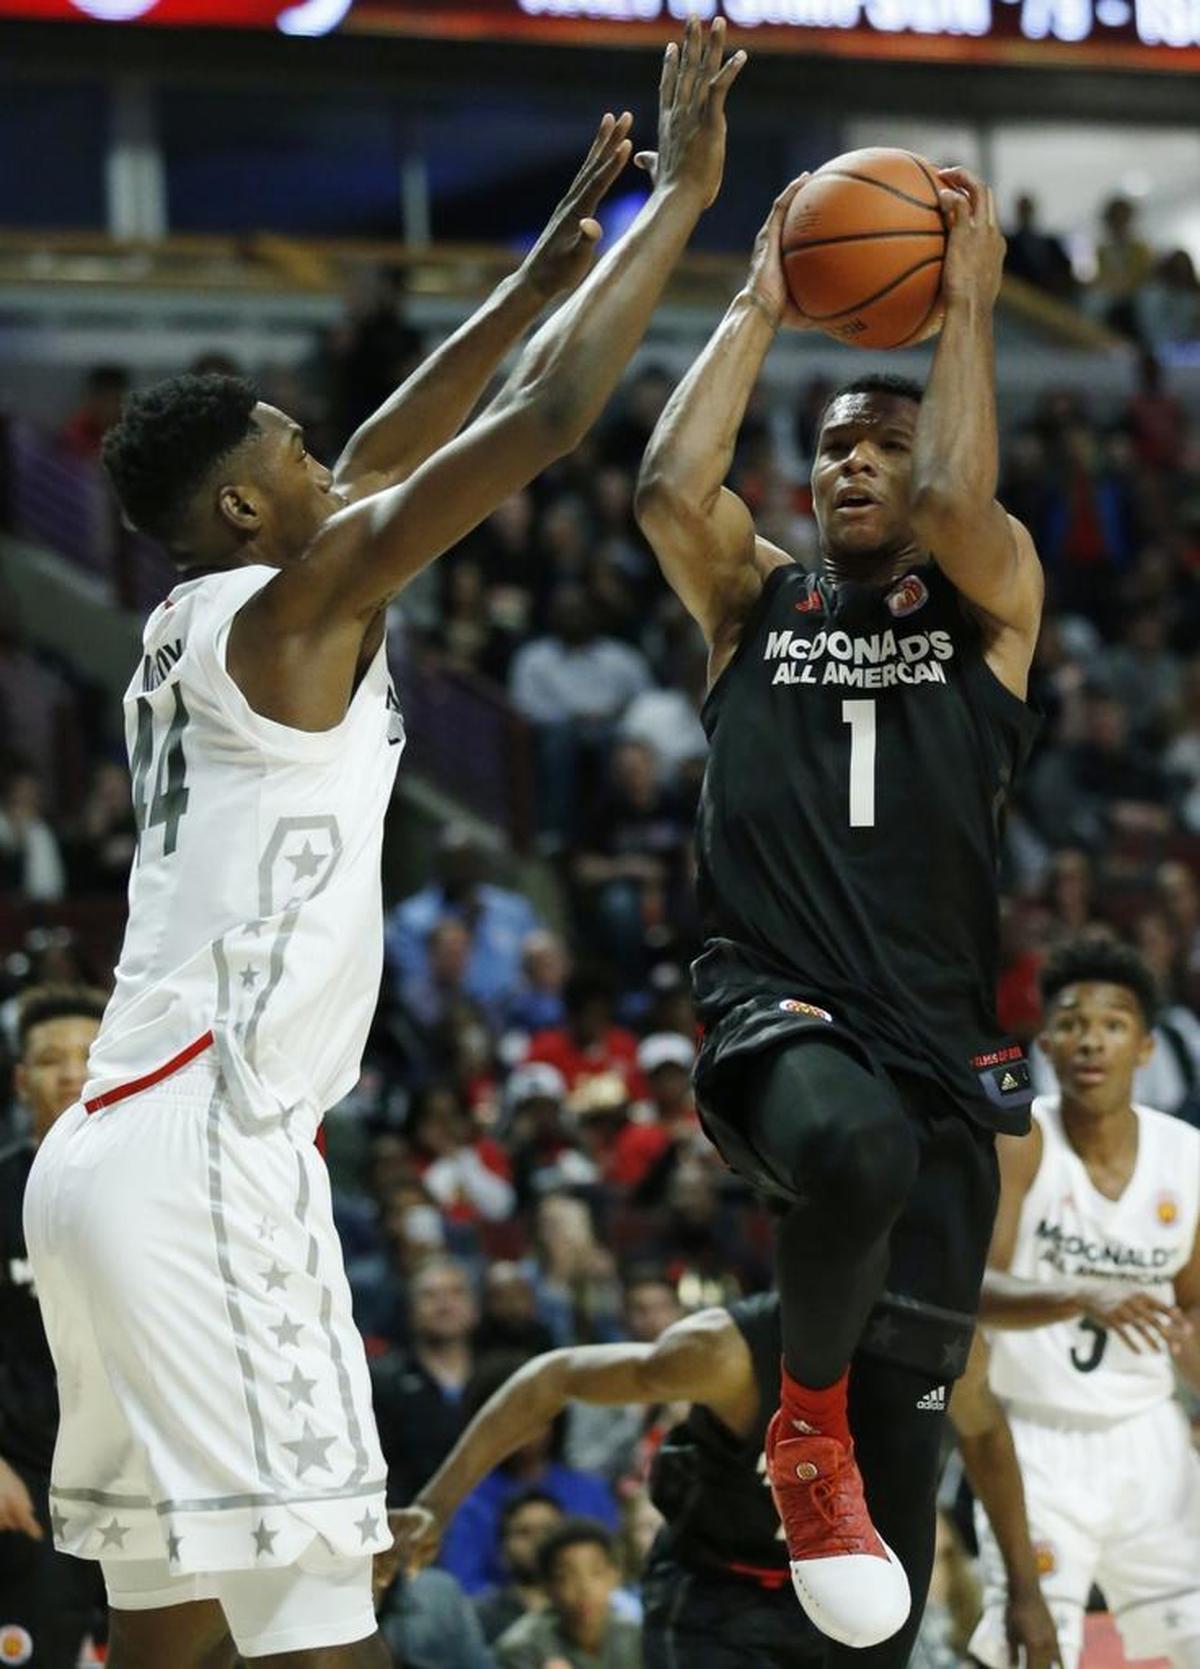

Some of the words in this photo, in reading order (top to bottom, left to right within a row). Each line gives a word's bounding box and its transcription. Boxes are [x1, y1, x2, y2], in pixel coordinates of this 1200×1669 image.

[763, 628, 954, 663] McDONAD'S
[772, 661, 817, 684] ALL
[822, 660, 947, 688] AMERCAN
[842, 699, 876, 827] 1
[916, 1400, 945, 1410] adida
